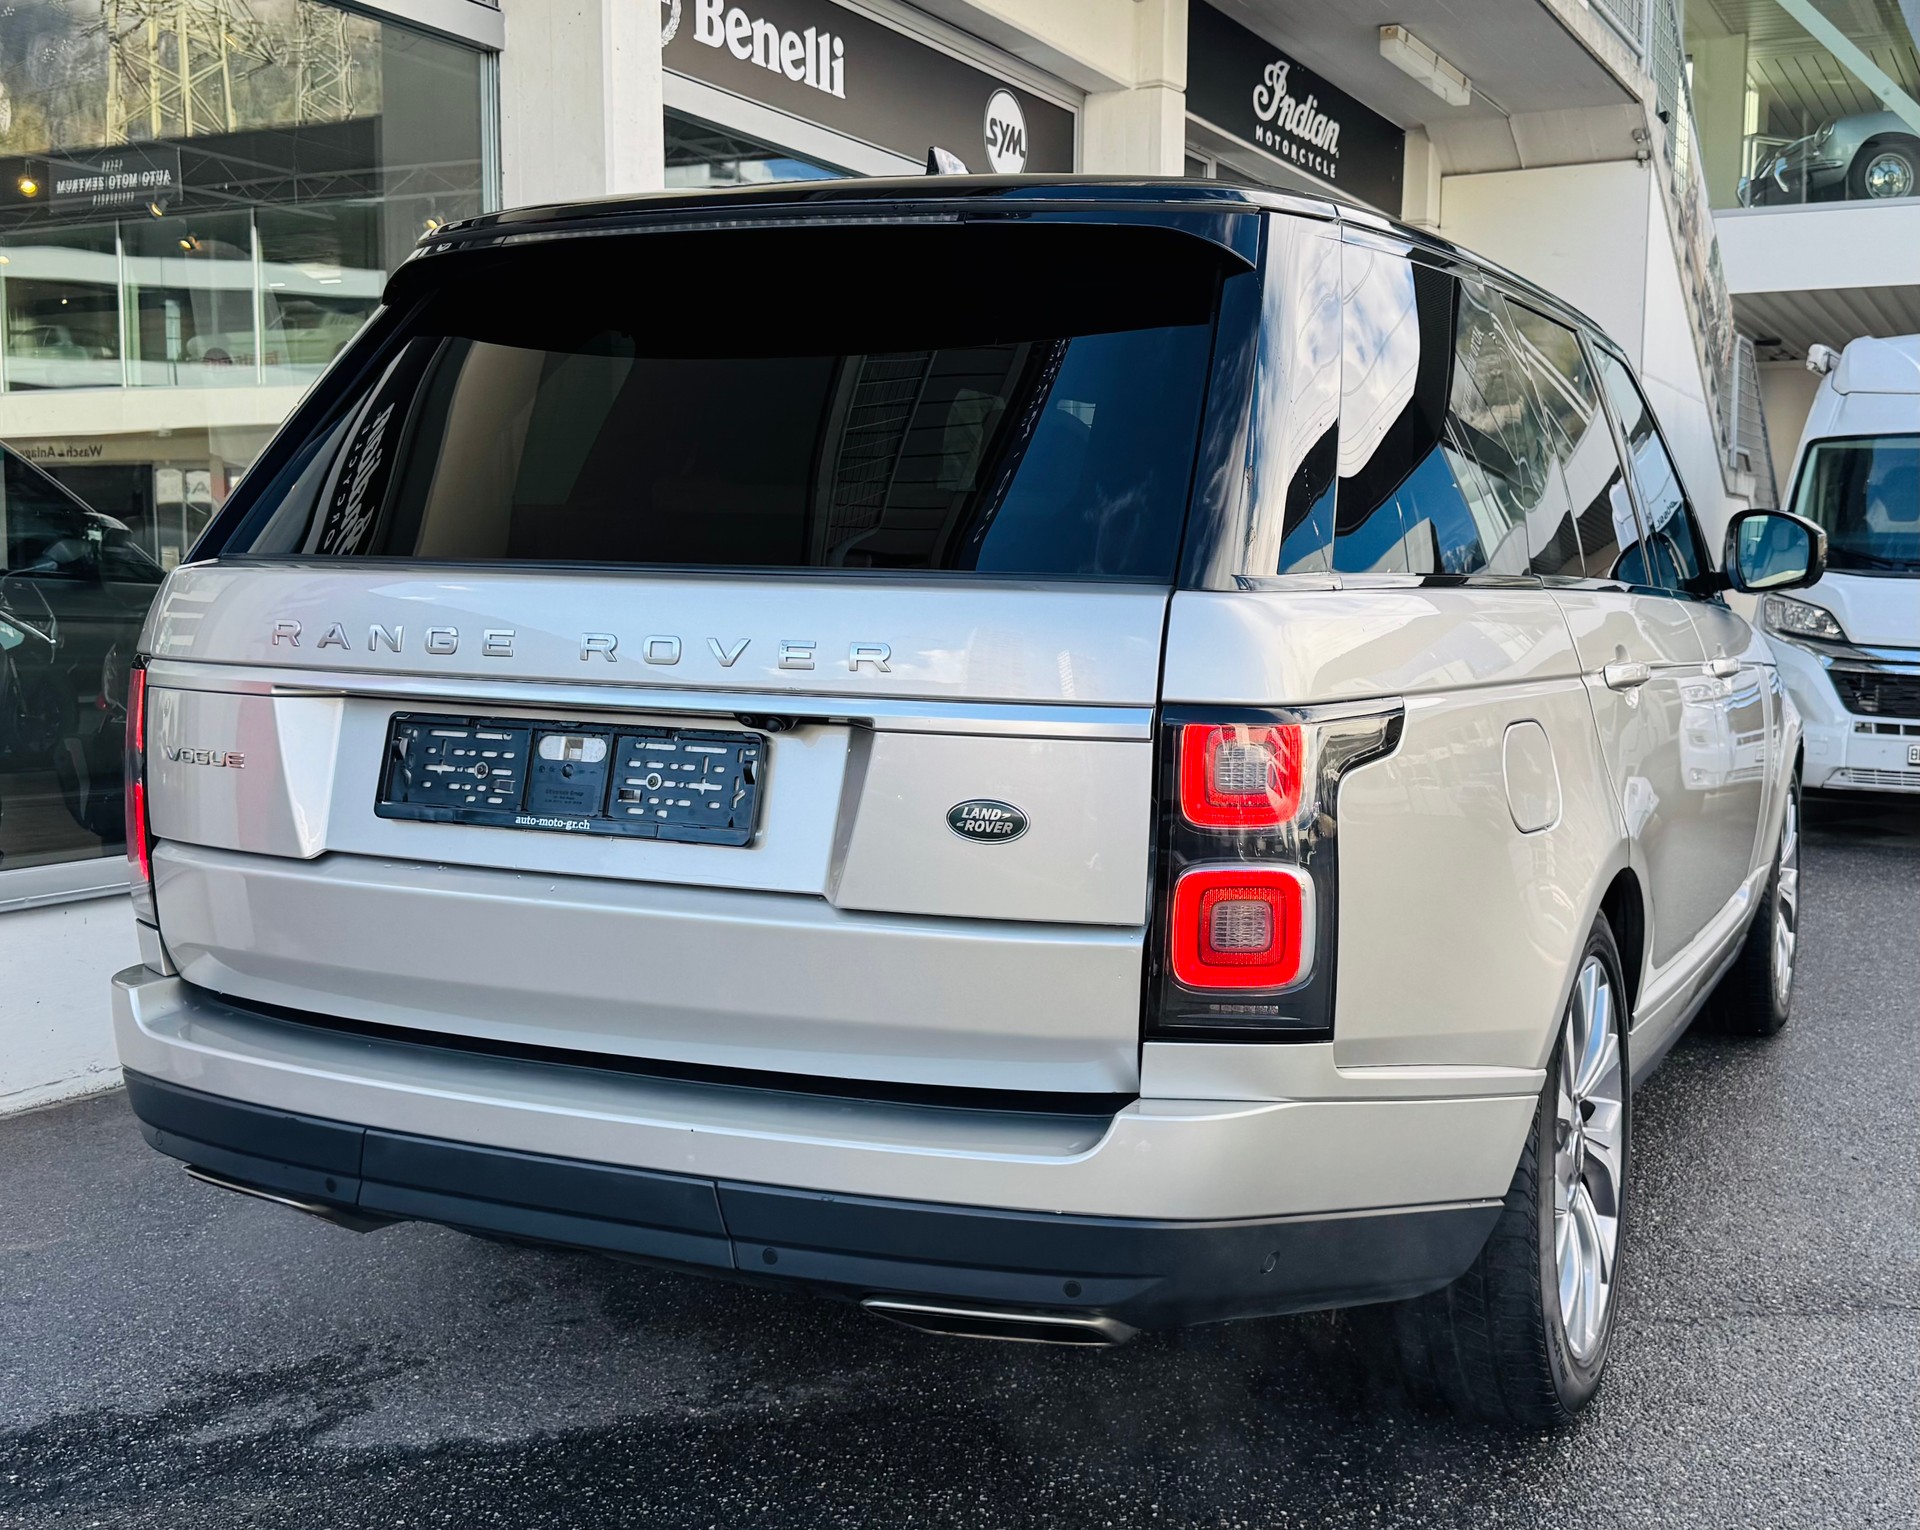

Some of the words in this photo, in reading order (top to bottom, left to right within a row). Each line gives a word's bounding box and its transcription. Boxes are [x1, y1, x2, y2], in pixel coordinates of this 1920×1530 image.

[693, 0, 846, 99] Benelli
[1253, 60, 1340, 155] Indian
[986, 117, 1026, 159] SYM
[1255, 124, 1336, 178] MOTORCYCLE
[271, 619, 516, 657] RANGE
[580, 632, 892, 673] ROVER
[166, 745, 245, 769] VOGUE
[515, 815, 590, 831] auto-moto-gr.ch
[961, 806, 1002, 821] LAND
[964, 819, 1014, 834] ROVER
